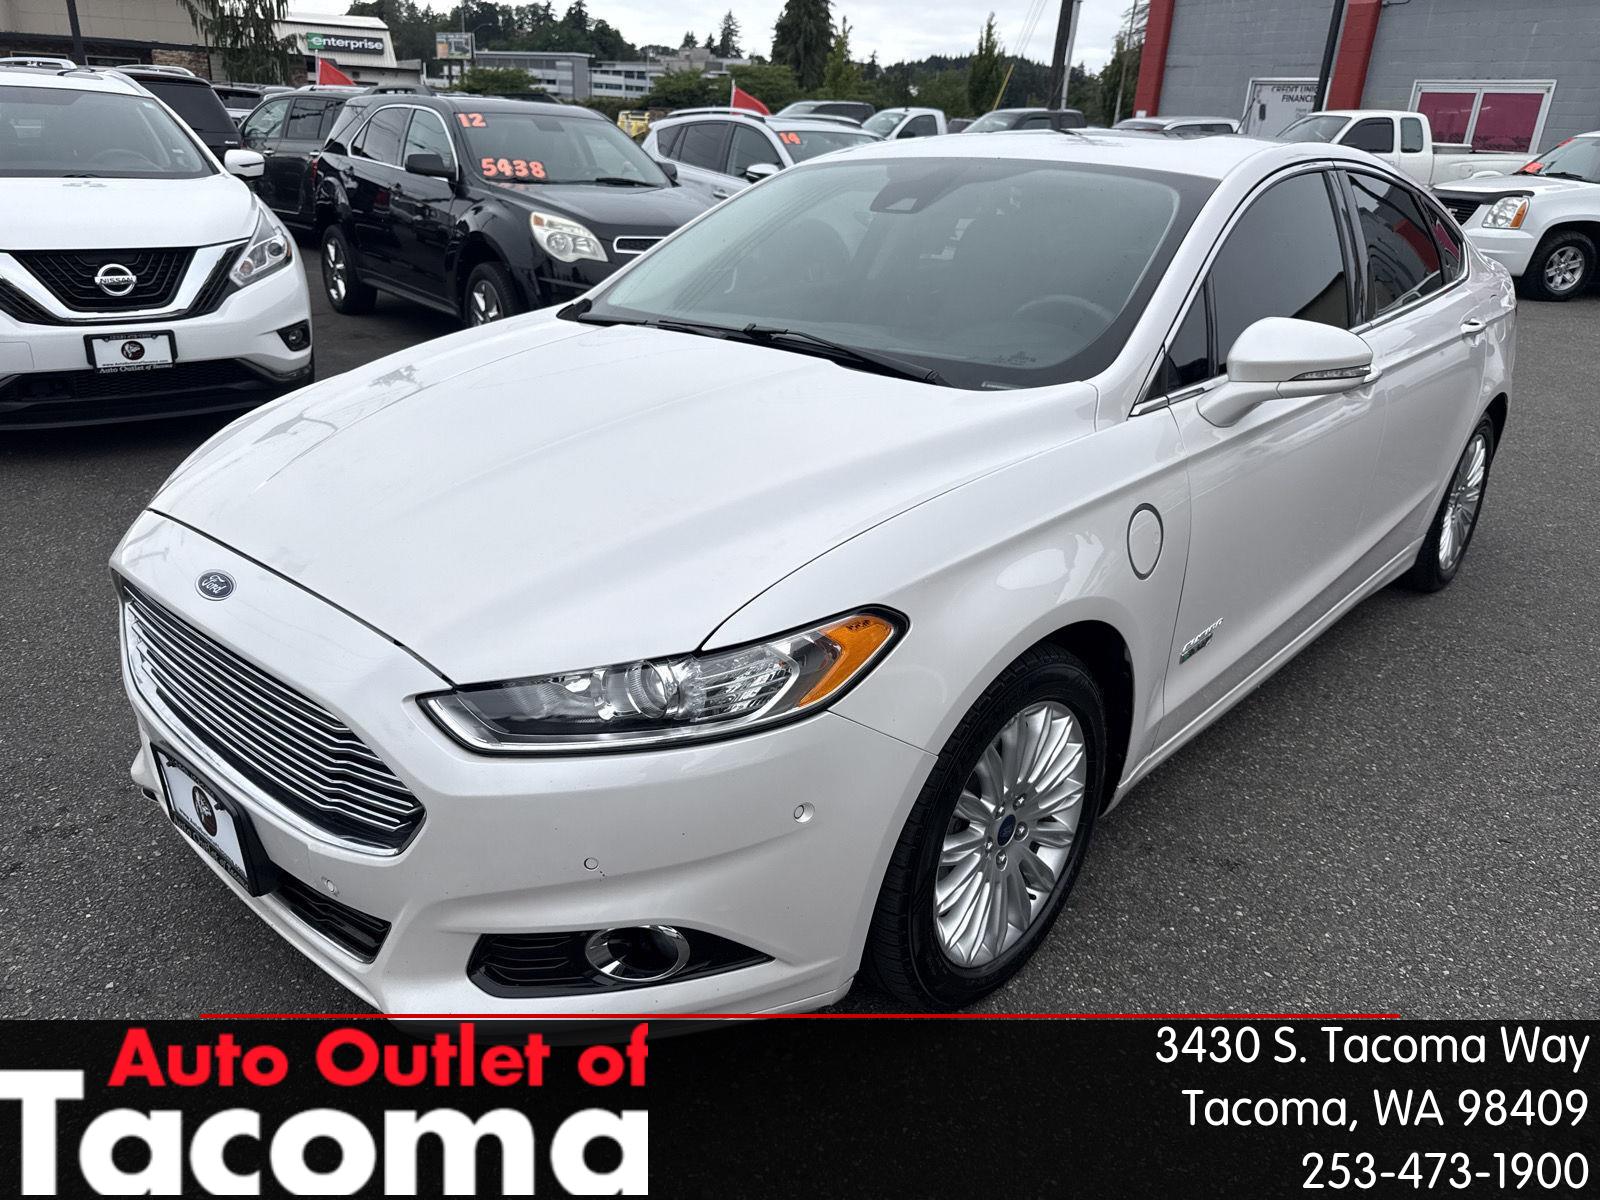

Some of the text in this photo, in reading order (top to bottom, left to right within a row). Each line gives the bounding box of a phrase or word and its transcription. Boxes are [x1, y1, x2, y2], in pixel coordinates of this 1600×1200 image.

[309, 36, 384, 50] enterprise
[1281, 94, 1313, 102] FINANCI
[457, 113, 487, 128] 12
[778, 131, 801, 145] 14
[481, 157, 546, 179] 5438
[100, 276, 135, 285] NISSAN
[202, 574, 227, 594] Ford
